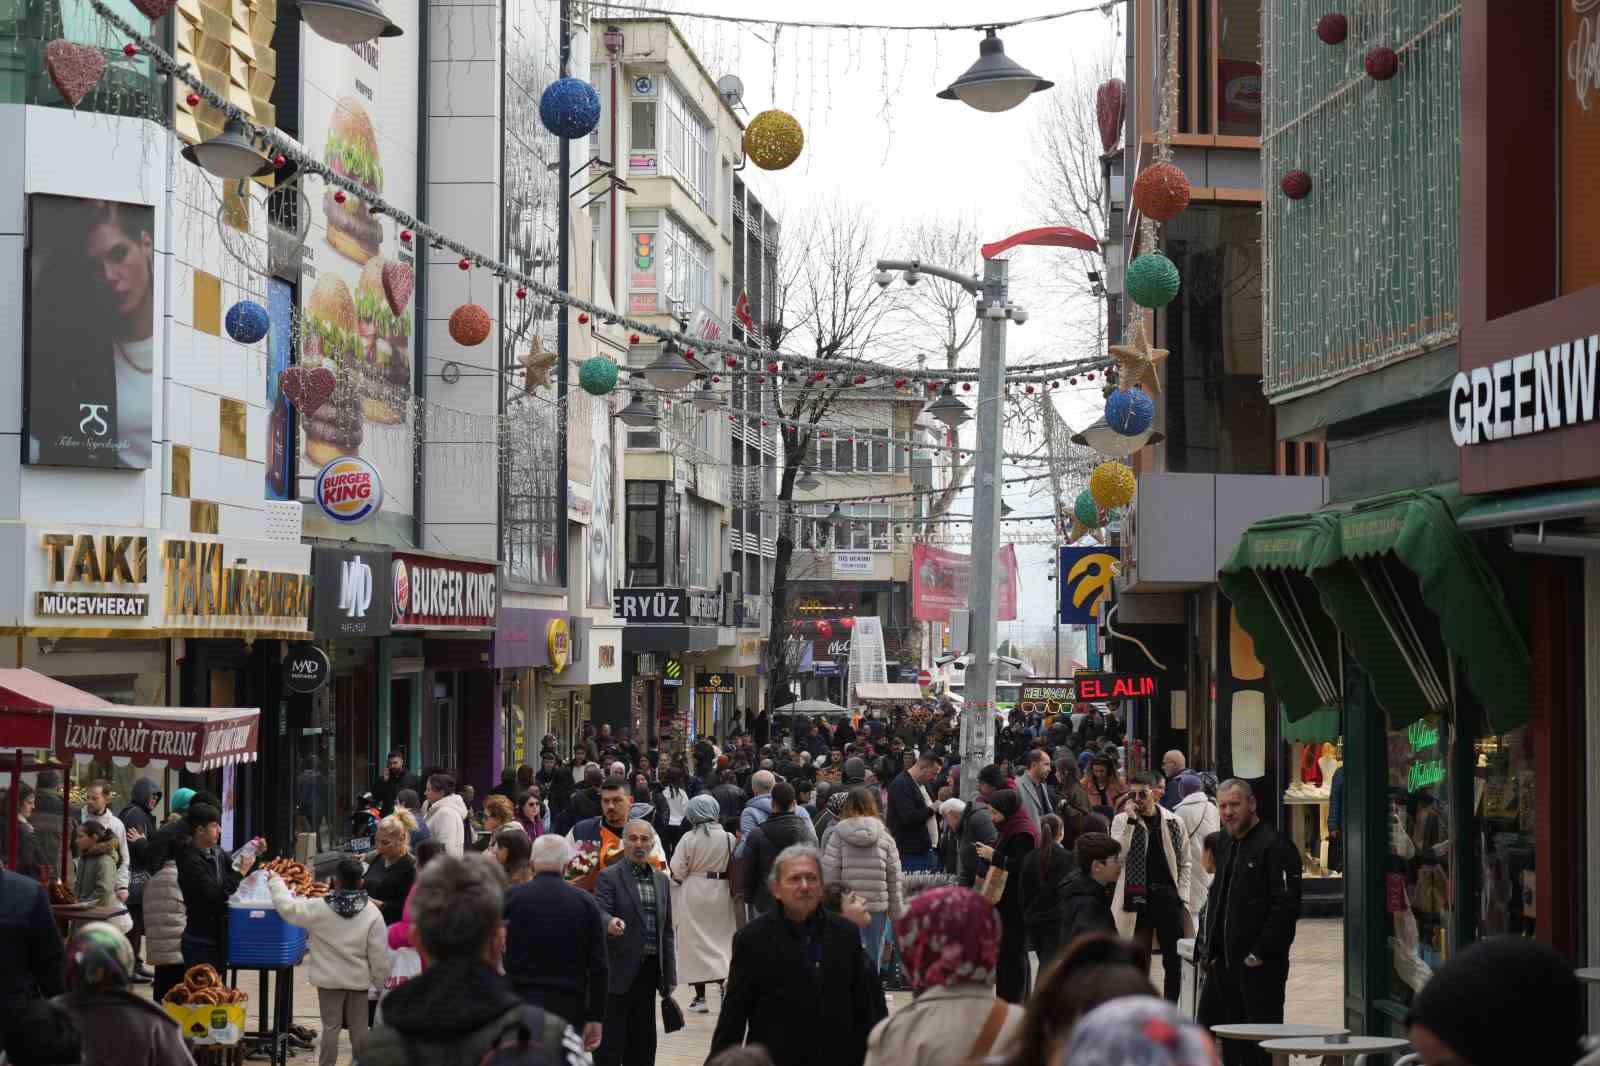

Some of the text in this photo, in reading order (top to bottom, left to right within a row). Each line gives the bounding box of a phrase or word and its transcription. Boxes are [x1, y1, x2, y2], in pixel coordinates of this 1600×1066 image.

[323, 472, 370, 490] BURGER
[323, 482, 372, 505] KING
[412, 566, 463, 617] BURGER
[466, 571, 496, 618] KING
[43, 594, 145, 616] MÜCEVHERAT
[292, 659, 318, 674] MAD
[1080, 680, 1108, 698] EL
[64, 717, 197, 757] İZMİT SİMİT FIRINI
